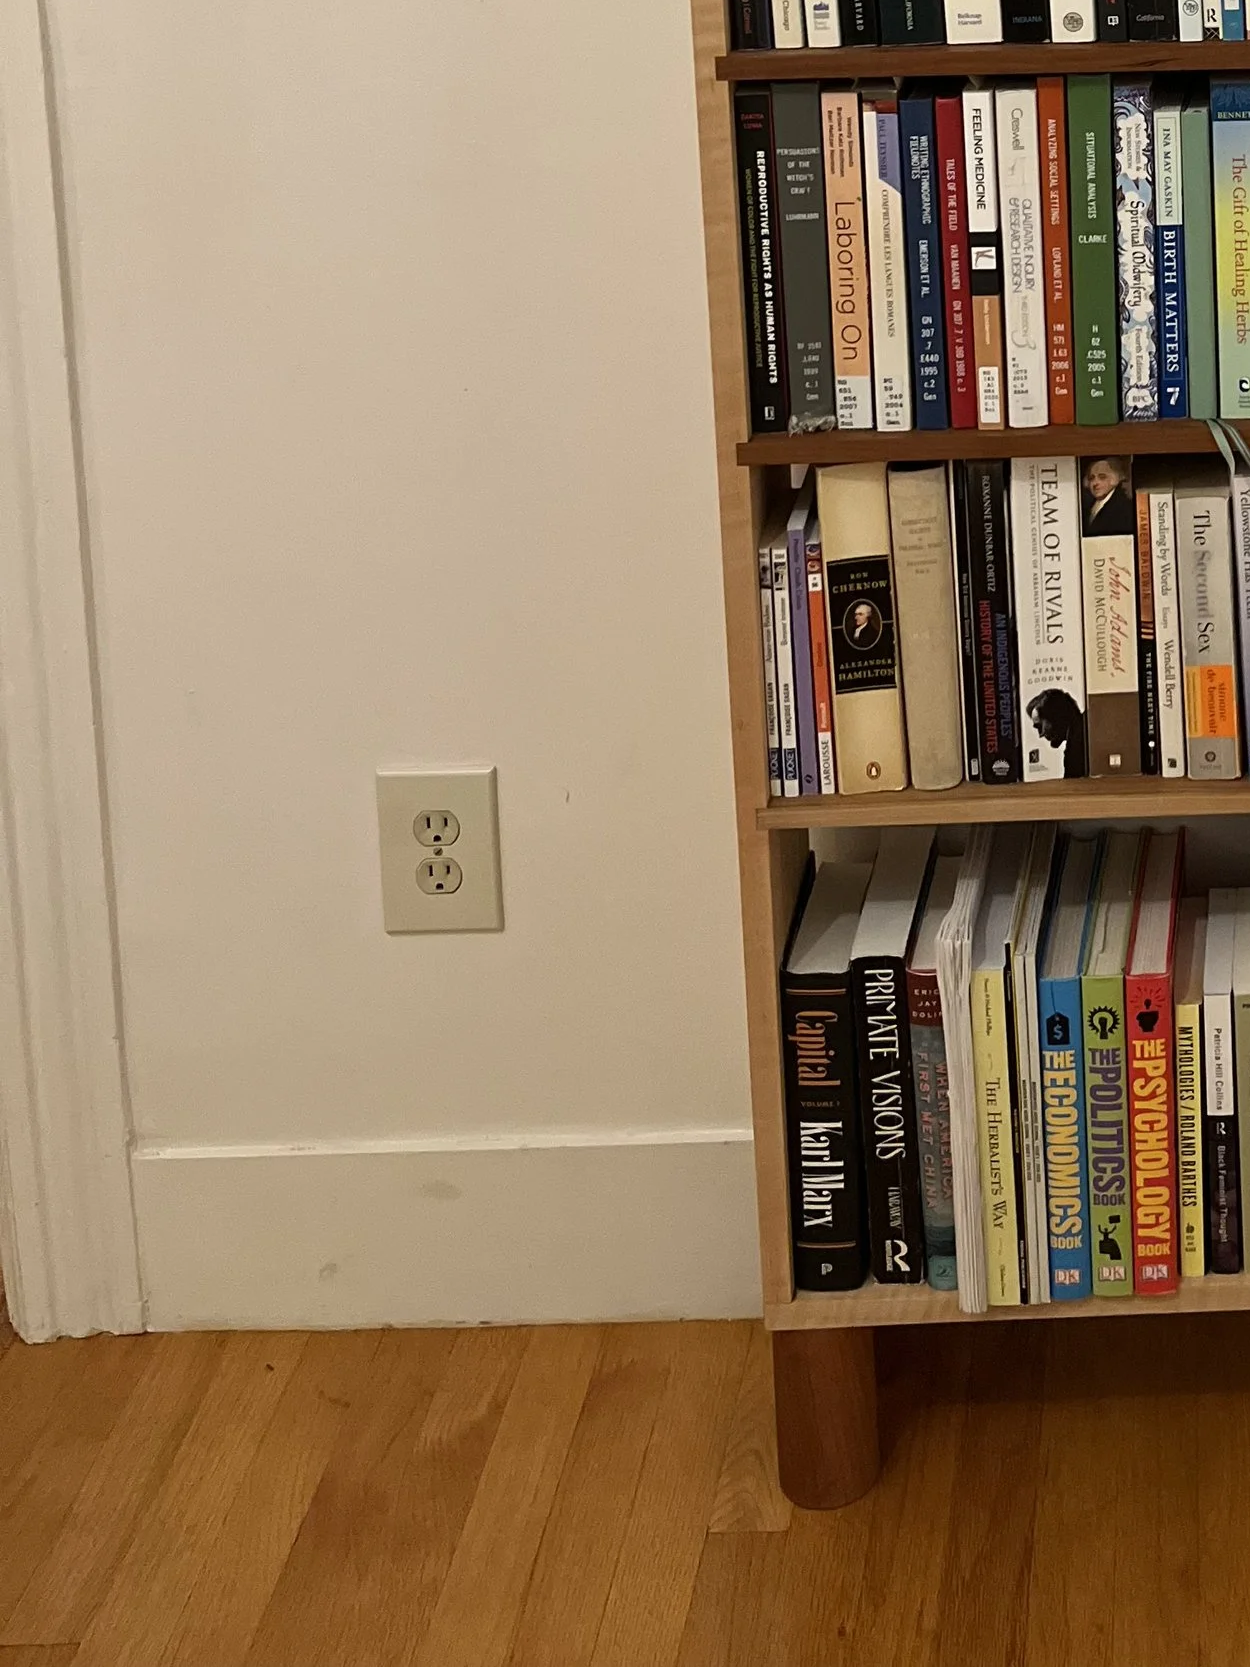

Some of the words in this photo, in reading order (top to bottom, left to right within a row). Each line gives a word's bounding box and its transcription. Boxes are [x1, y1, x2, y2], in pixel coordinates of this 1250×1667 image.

[973, 108, 985, 155] FEELING
[974, 158, 986, 209] MEDICINE
[1232, 155, 1247, 183] The
[1129, 200, 1146, 247] Spiritual
[1232, 187, 1248, 216] Gift
[1234, 220, 1248, 236] of
[834, 201, 859, 314] Laboring
[1129, 252, 1146, 307] Midwifery
[1163, 231, 1176, 283] BIRTH
[1231, 239, 1249, 297] Healing
[841, 325, 862, 361] On
[1166, 293, 1179, 372] MATTERS
[1236, 301, 1250, 344] Herbs
[1041, 464, 1059, 528] TEAM
[1044, 534, 1060, 562] OF
[1193, 511, 1212, 545] The
[1046, 571, 1064, 645] RIVALS
[1194, 550, 1213, 618] Second
[1163, 640, 1176, 680] Wendell
[1196, 622, 1214, 654] Sex
[1163, 684, 1176, 709] Berry
[864, 969, 900, 1060] PRIMATE
[787, 1010, 841, 1086] Capital
[1178, 1026, 1193, 1101] MYTHOLOGIES
[872, 1070, 906, 1159] VISIONS
[985, 1078, 1000, 1108] THE
[799, 1121, 844, 1166] Karl
[987, 1112, 1004, 1196] HERBALIST'S
[1043, 1069, 1083, 1236] ECONOMICS
[1090, 1065, 1125, 1194] POLITICS
[1133, 1059, 1170, 1240] PSYCHOLOGY
[1180, 1115, 1195, 1157] ROLAND
[801, 1173, 844, 1228] Marx
[1181, 1160, 1196, 1207] BARTHES
[992, 1200, 1007, 1229] WAY
